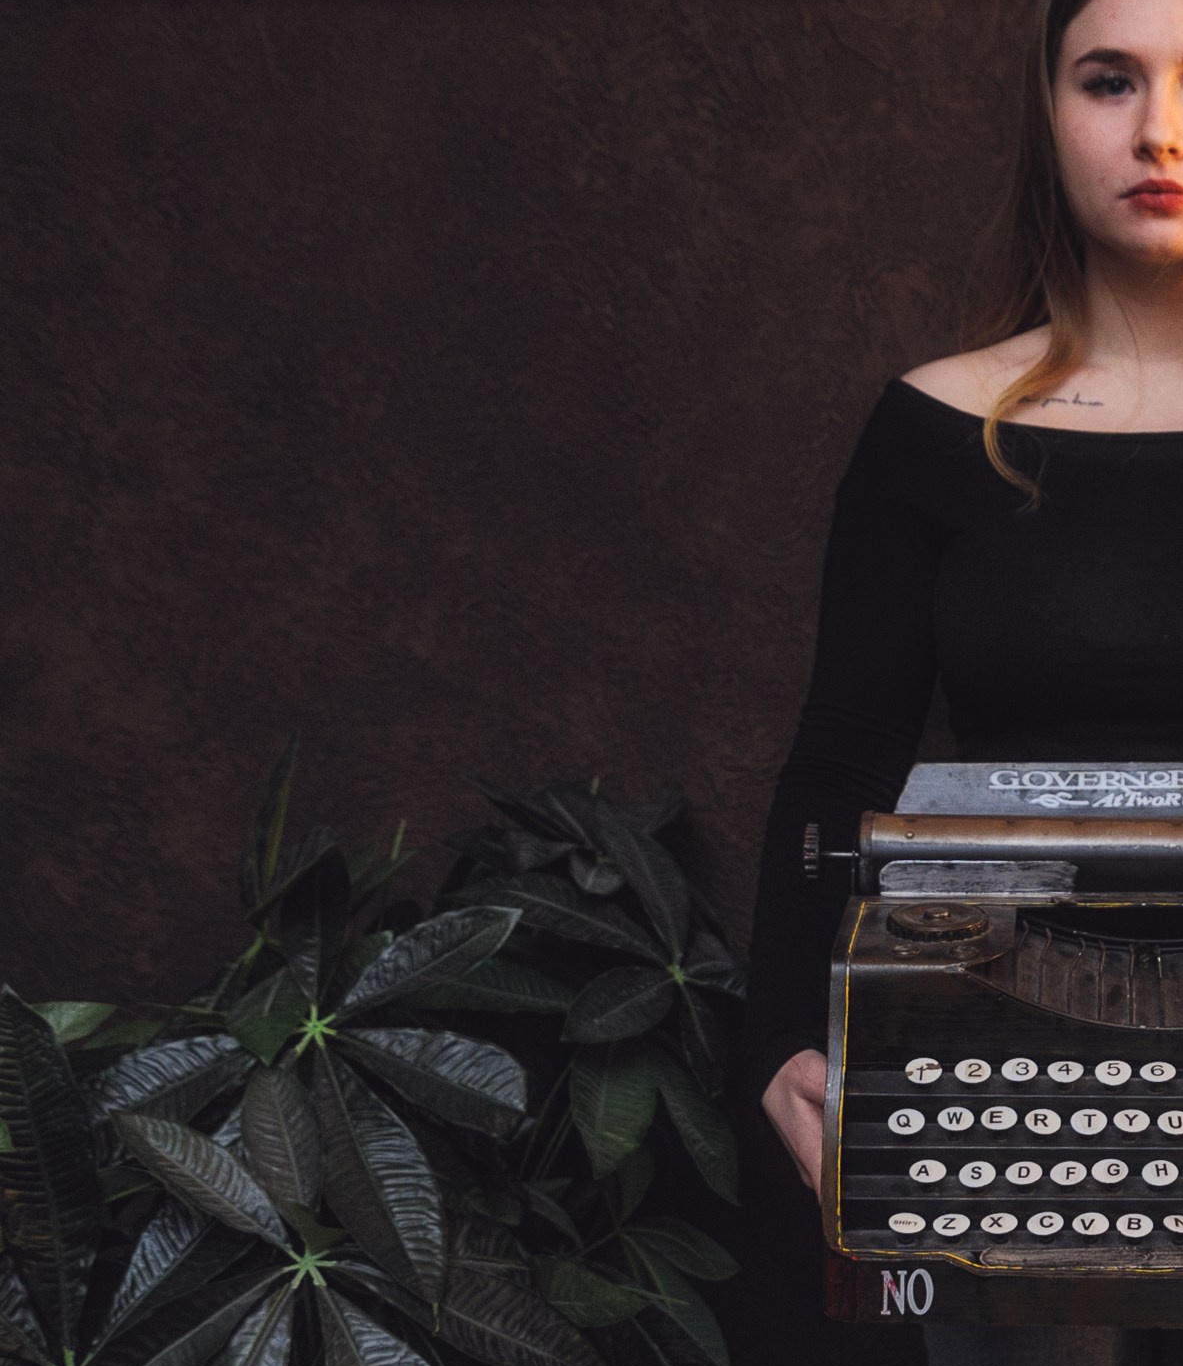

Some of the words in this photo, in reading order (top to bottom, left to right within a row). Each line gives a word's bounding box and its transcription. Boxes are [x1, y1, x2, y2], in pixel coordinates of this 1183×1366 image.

[968, 1063, 982, 1077] 2
[1016, 1062, 1029, 1075] 3
[1058, 1064, 1072, 1075] 4
[1107, 1063, 1121, 1076] 5
[1150, 1065, 1164, 1076] 6
[896, 1114, 911, 1128] Q
[947, 1112, 963, 1125] W
[989, 1111, 1003, 1124] E
[1034, 1113, 1048, 1127] R
[1083, 1114, 1096, 1128] T
[1124, 1114, 1138, 1126] Y
[1168, 1116, 1182, 1129] U
[916, 1165, 929, 1176] A
[971, 1166, 982, 1180] S
[1018, 1166, 1030, 1178] D
[1066, 1167, 1076, 1180] F
[1107, 1163, 1120, 1176] G
[1155, 1163, 1168, 1177] H
[893, 1219, 918, 1227] SHIFT
[942, 1218, 956, 1229] Z
[988, 1216, 1003, 1228] X
[1039, 1215, 1054, 1228] C
[1080, 1219, 1095, 1231] V
[1127, 1217, 1141, 1230] B
[881, 1268, 934, 1315] NO
